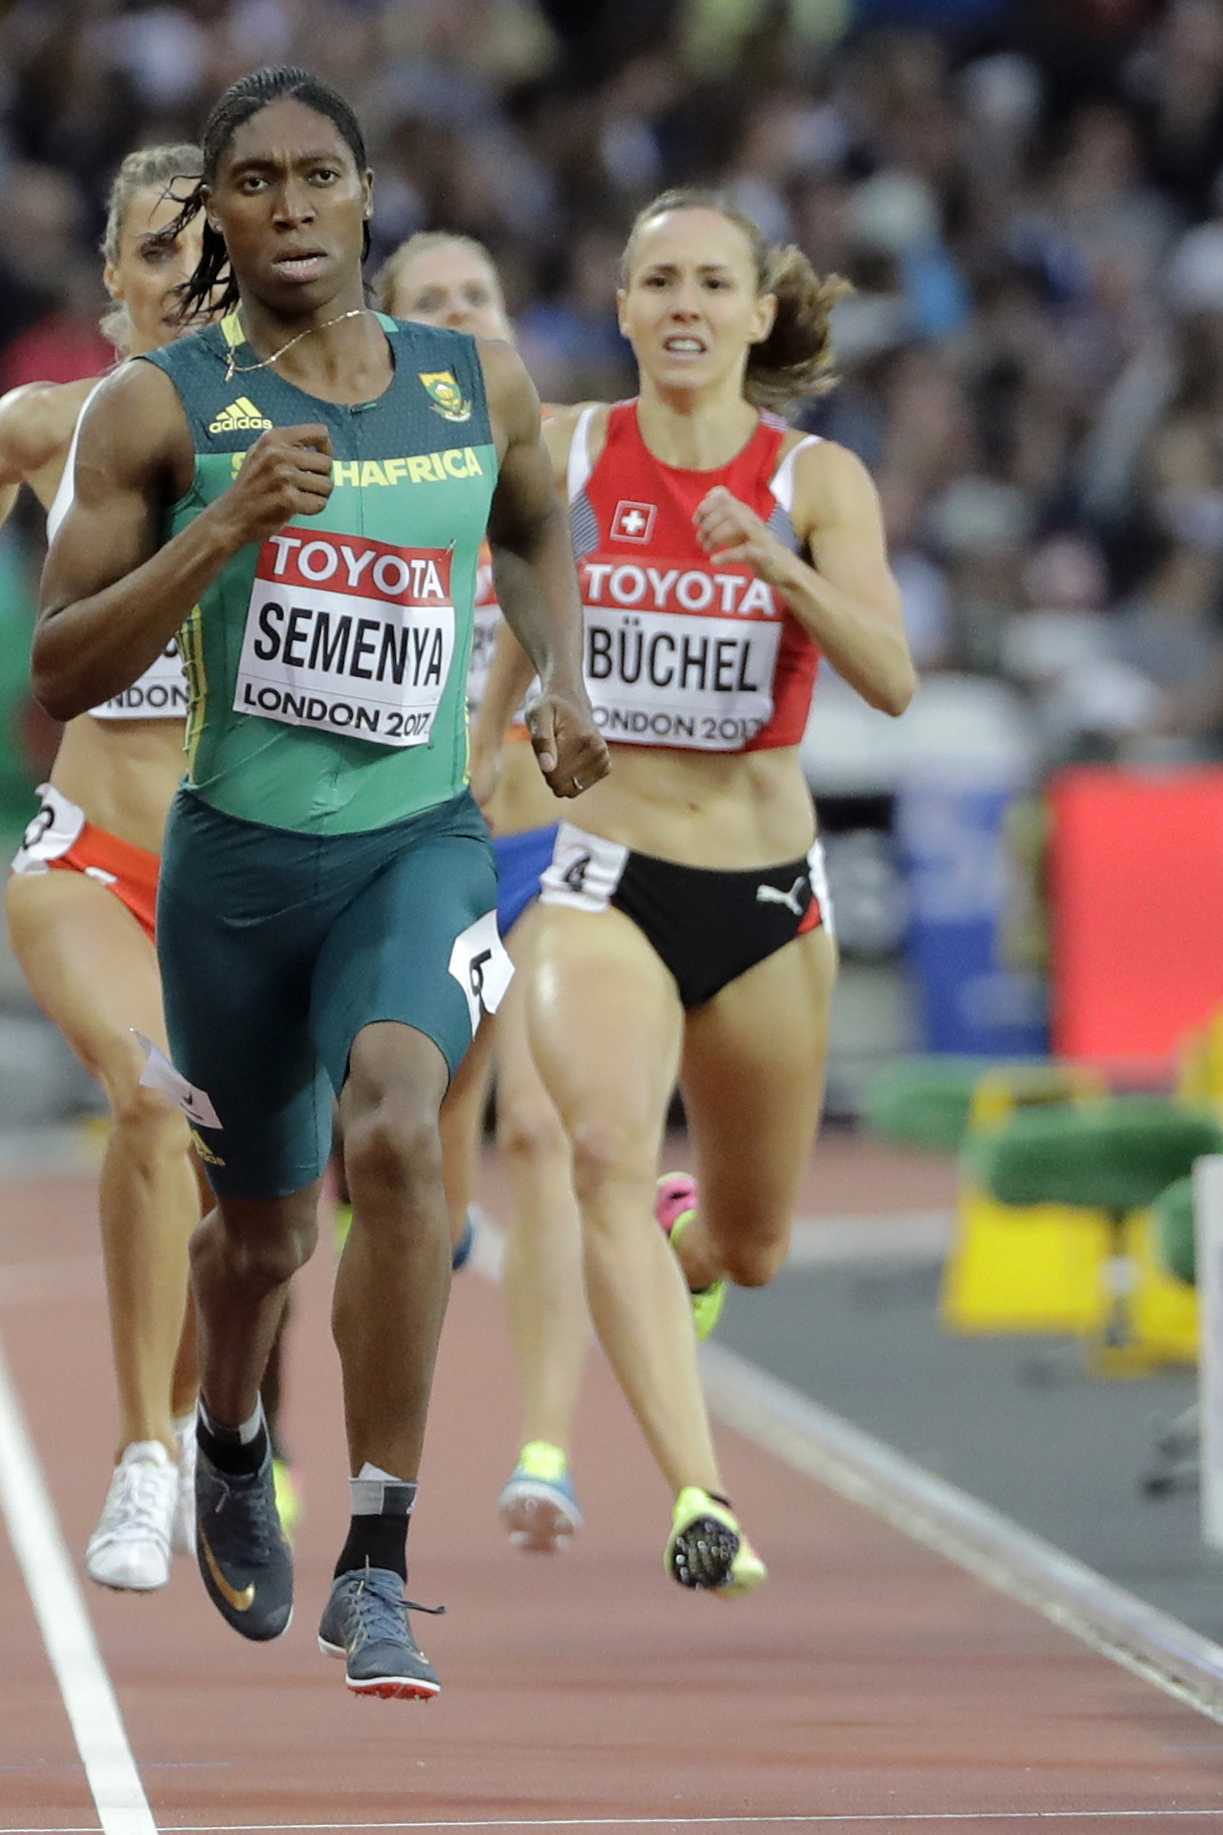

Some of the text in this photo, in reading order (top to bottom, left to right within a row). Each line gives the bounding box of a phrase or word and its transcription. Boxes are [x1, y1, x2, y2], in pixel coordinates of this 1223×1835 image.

[209, 415, 273, 434] adidas
[269, 535, 445, 599] TOYOTA
[584, 563, 776, 616] TOYOTA
[253, 601, 443, 688] SEMENYA
[587, 615, 758, 693] BÜCHEL
[244, 683, 432, 737] LONDON 2017
[591, 705, 695, 737] ONDON
